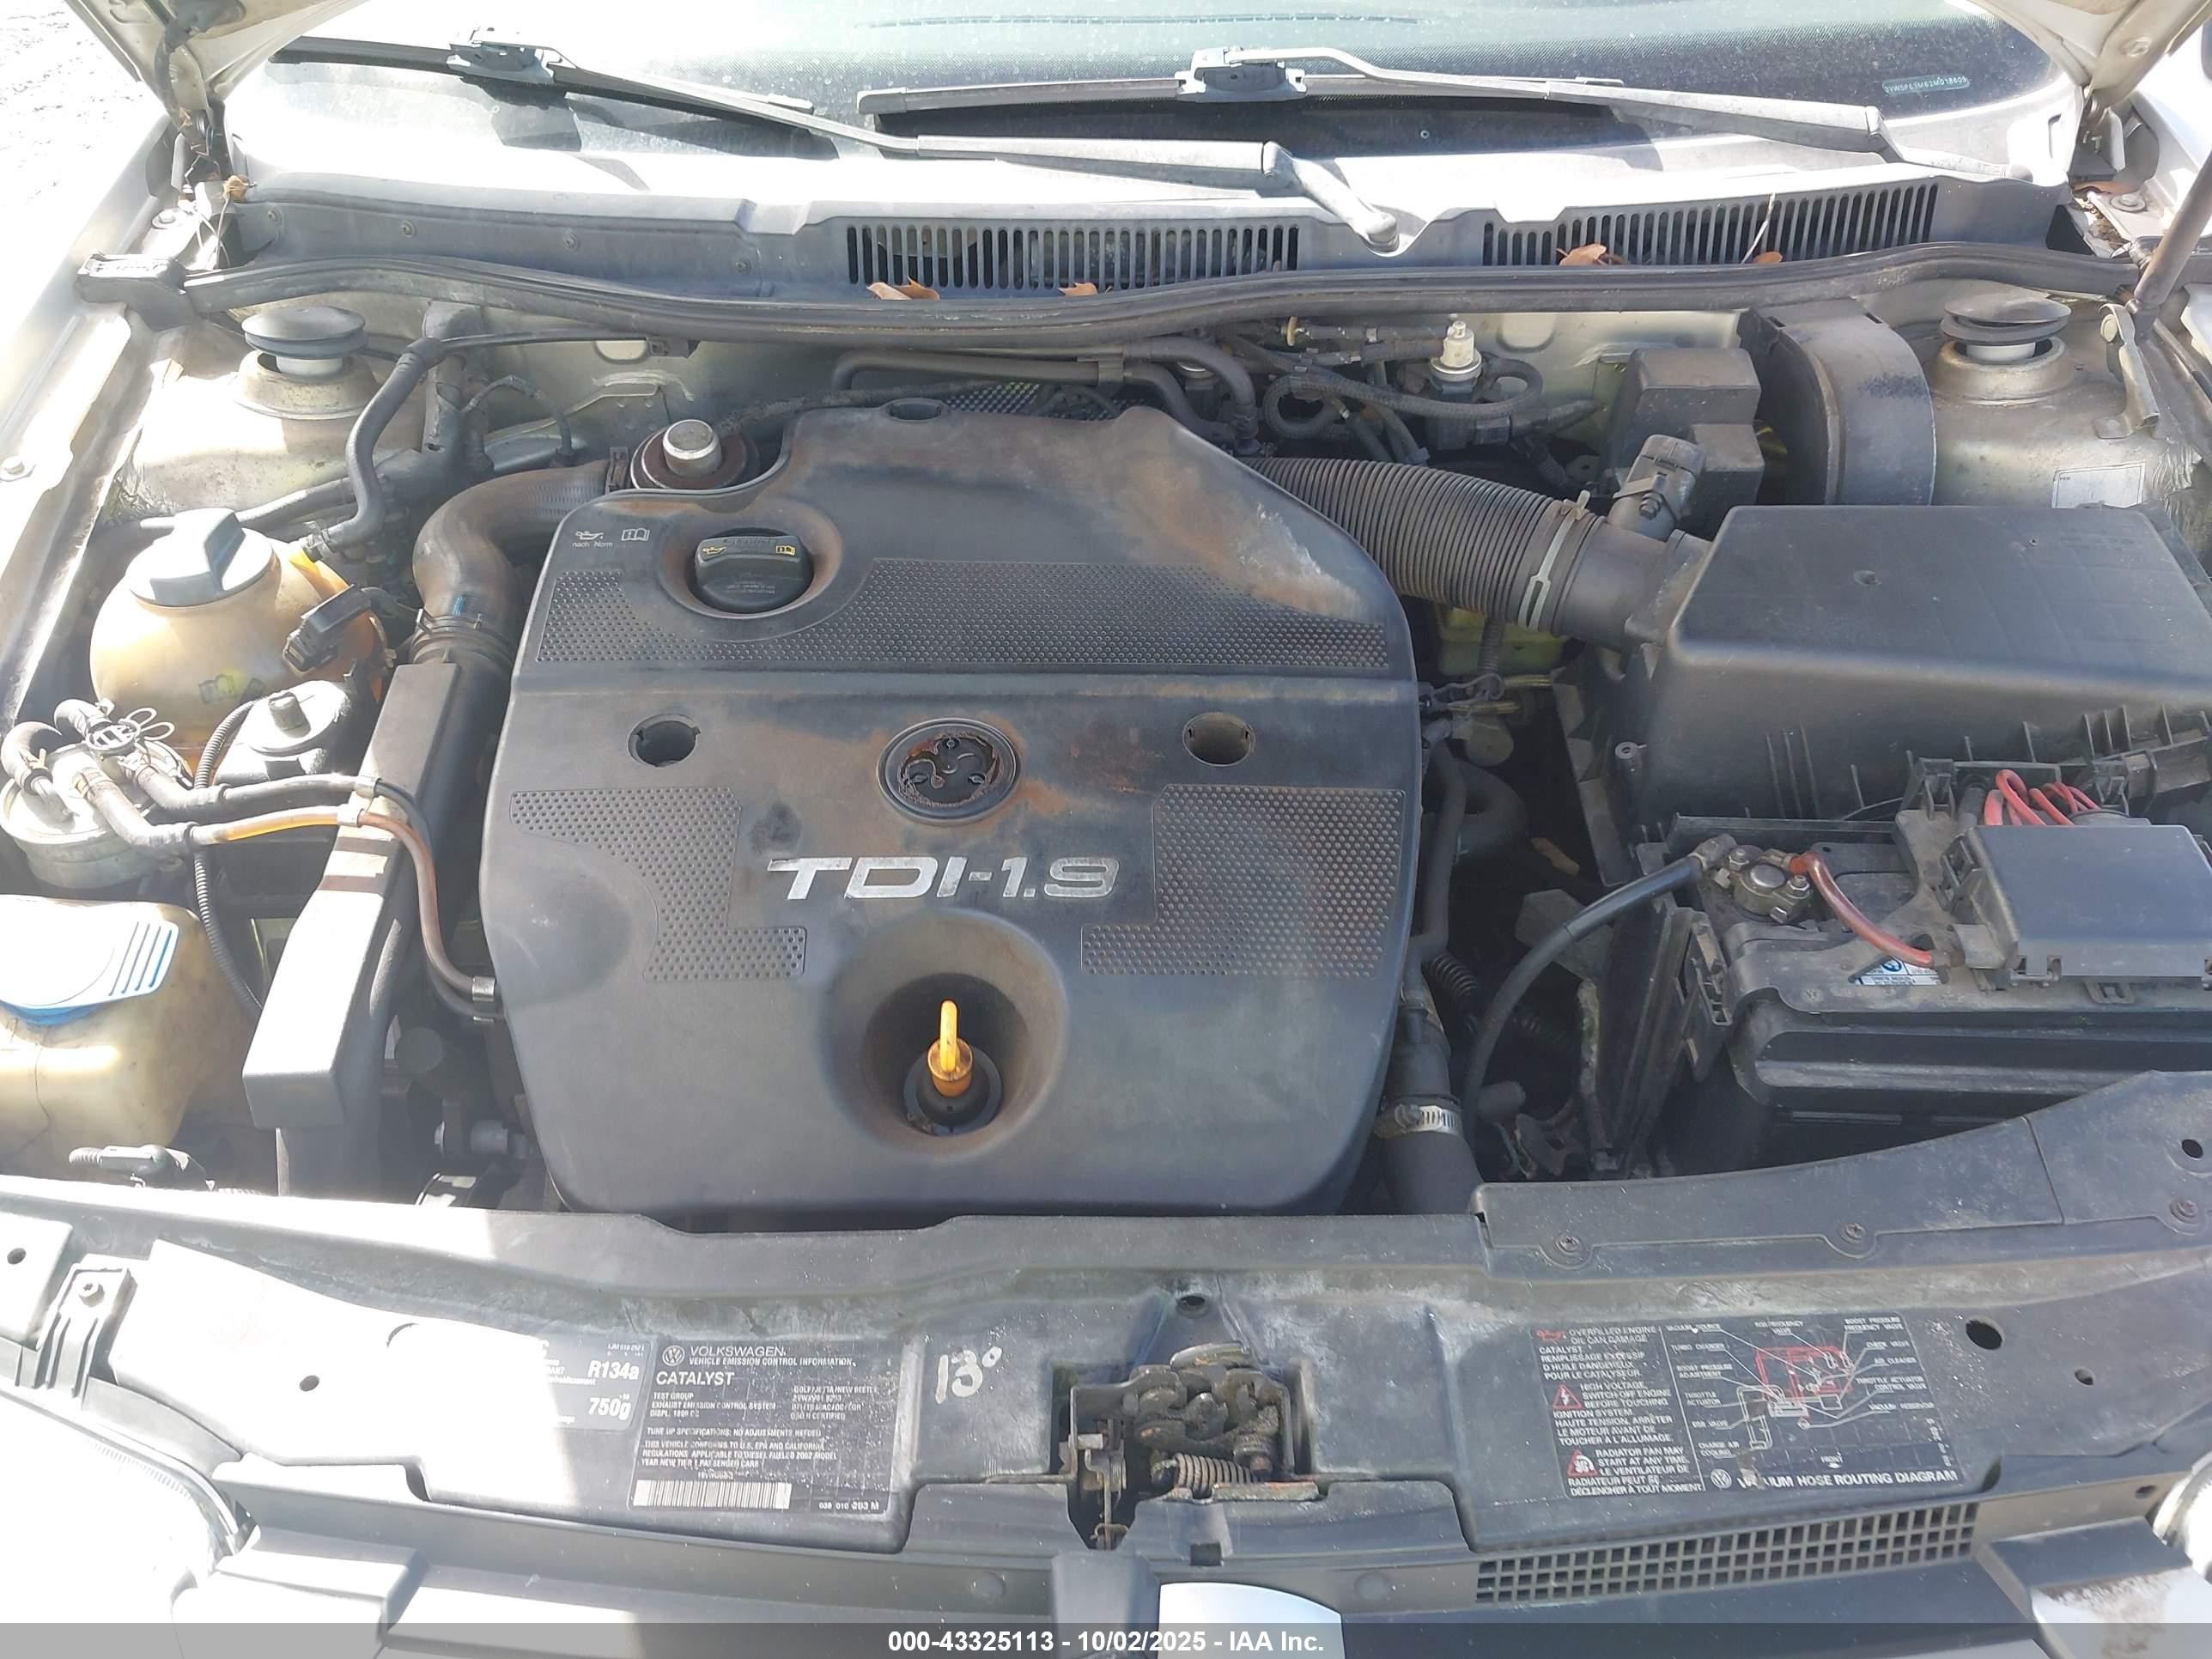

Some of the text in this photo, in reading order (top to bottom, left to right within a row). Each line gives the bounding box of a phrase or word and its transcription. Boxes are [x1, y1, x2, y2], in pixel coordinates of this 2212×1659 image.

[767, 856, 1120, 900] TDI-1.9
[1587, 1335, 1607, 1344] CAN
[1607, 1334, 1649, 1344] DAMAGE
[1539, 1346, 1583, 1354] CATALYST
[689, 1357, 720, 1365] VEHICLE
[723, 1358, 760, 1366] EMISSION
[762, 1358, 797, 1366] CONTROL
[587, 1359, 640, 1381] R134a
[656, 1371, 735, 1386] CATALYST
[1544, 1371, 1571, 1381] POUR
[1571, 1371, 1581, 1380] LE
[1580, 1382, 1603, 1391] HIGH
[653, 1392, 694, 1401] TEST GROUP
[1582, 1388, 1672, 1401] SWITCH OFF ENGINE
[588, 1396, 631, 1420] 750g
[1583, 1400, 1620, 1409] BEFORE
[1553, 1410, 1594, 1419] IGNITION
[1554, 1419, 1586, 1428] HAUTE
[647, 1426, 665, 1435] TUNE
[665, 1426, 676, 1435] UP
[1556, 1424, 1656, 1437] LE MOTEUR AVANT DE
[644, 1440, 659, 1449] THIS
[661, 1440, 688, 1449] VEHICLE
[729, 1441, 738, 1449] TO
[755, 1442, 768, 1450] EPA
[769, 1442, 783, 1450] AND
[1559, 1437, 1603, 1447] TOUCHER
[690, 1449, 732, 1459] APPLICABLE
[733, 1450, 744, 1459] TO
[744, 1450, 768, 1460] DIESEL
[815, 1452, 837, 1461] MODEL
[1595, 1446, 1684, 1458] RADIATOR FAN MAY
[641, 1458, 659, 1467] YEAR
[660, 1458, 677, 1468] NEW
[1597, 1457, 1628, 1468] START
[1629, 1457, 1642, 1466] AT
[1642, 1456, 1663, 1466] ANY
[1600, 1464, 1690, 1476] LE VENTILATEUR DE
[1567, 1476, 1620, 1486] RADIATEUR
[1621, 1475, 1645, 1486] PEUT
[1797, 1474, 1833, 1487] HOSE
[1834, 1473, 1893, 1486] ROUTING
[1895, 1469, 1959, 1484] DIAGRAM
[1635, 1484, 1661, 1494] TOUT
